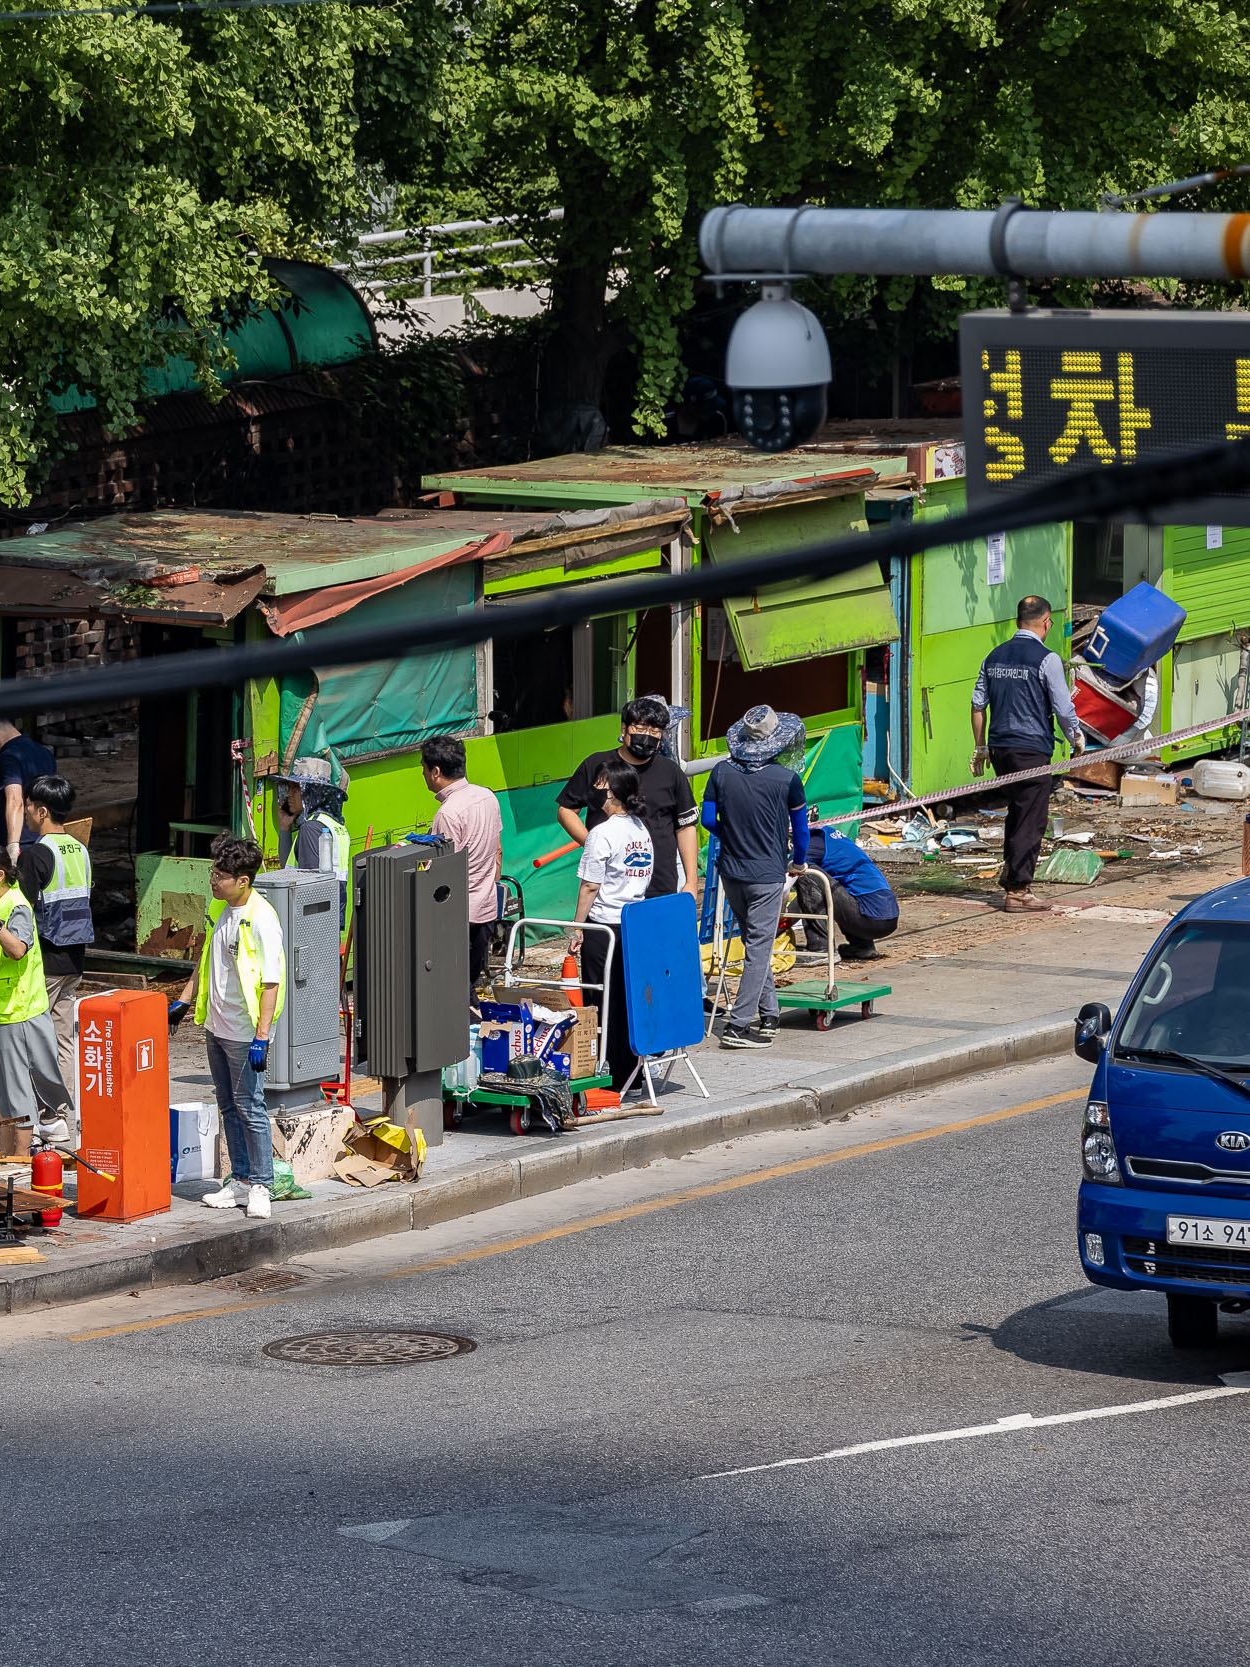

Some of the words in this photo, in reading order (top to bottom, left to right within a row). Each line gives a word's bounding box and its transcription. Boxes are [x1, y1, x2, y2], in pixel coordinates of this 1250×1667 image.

[57, 843, 82, 855] 광진구
[104, 1020, 113, 1038] Fire
[83, 1020, 103, 1097] 소화기
[104, 1040, 113, 1098] Extinguisher
[1220, 1135, 1246, 1148] KIA
[1178, 1221, 1214, 1241] 91소
[1223, 1225, 1250, 1245] 94
